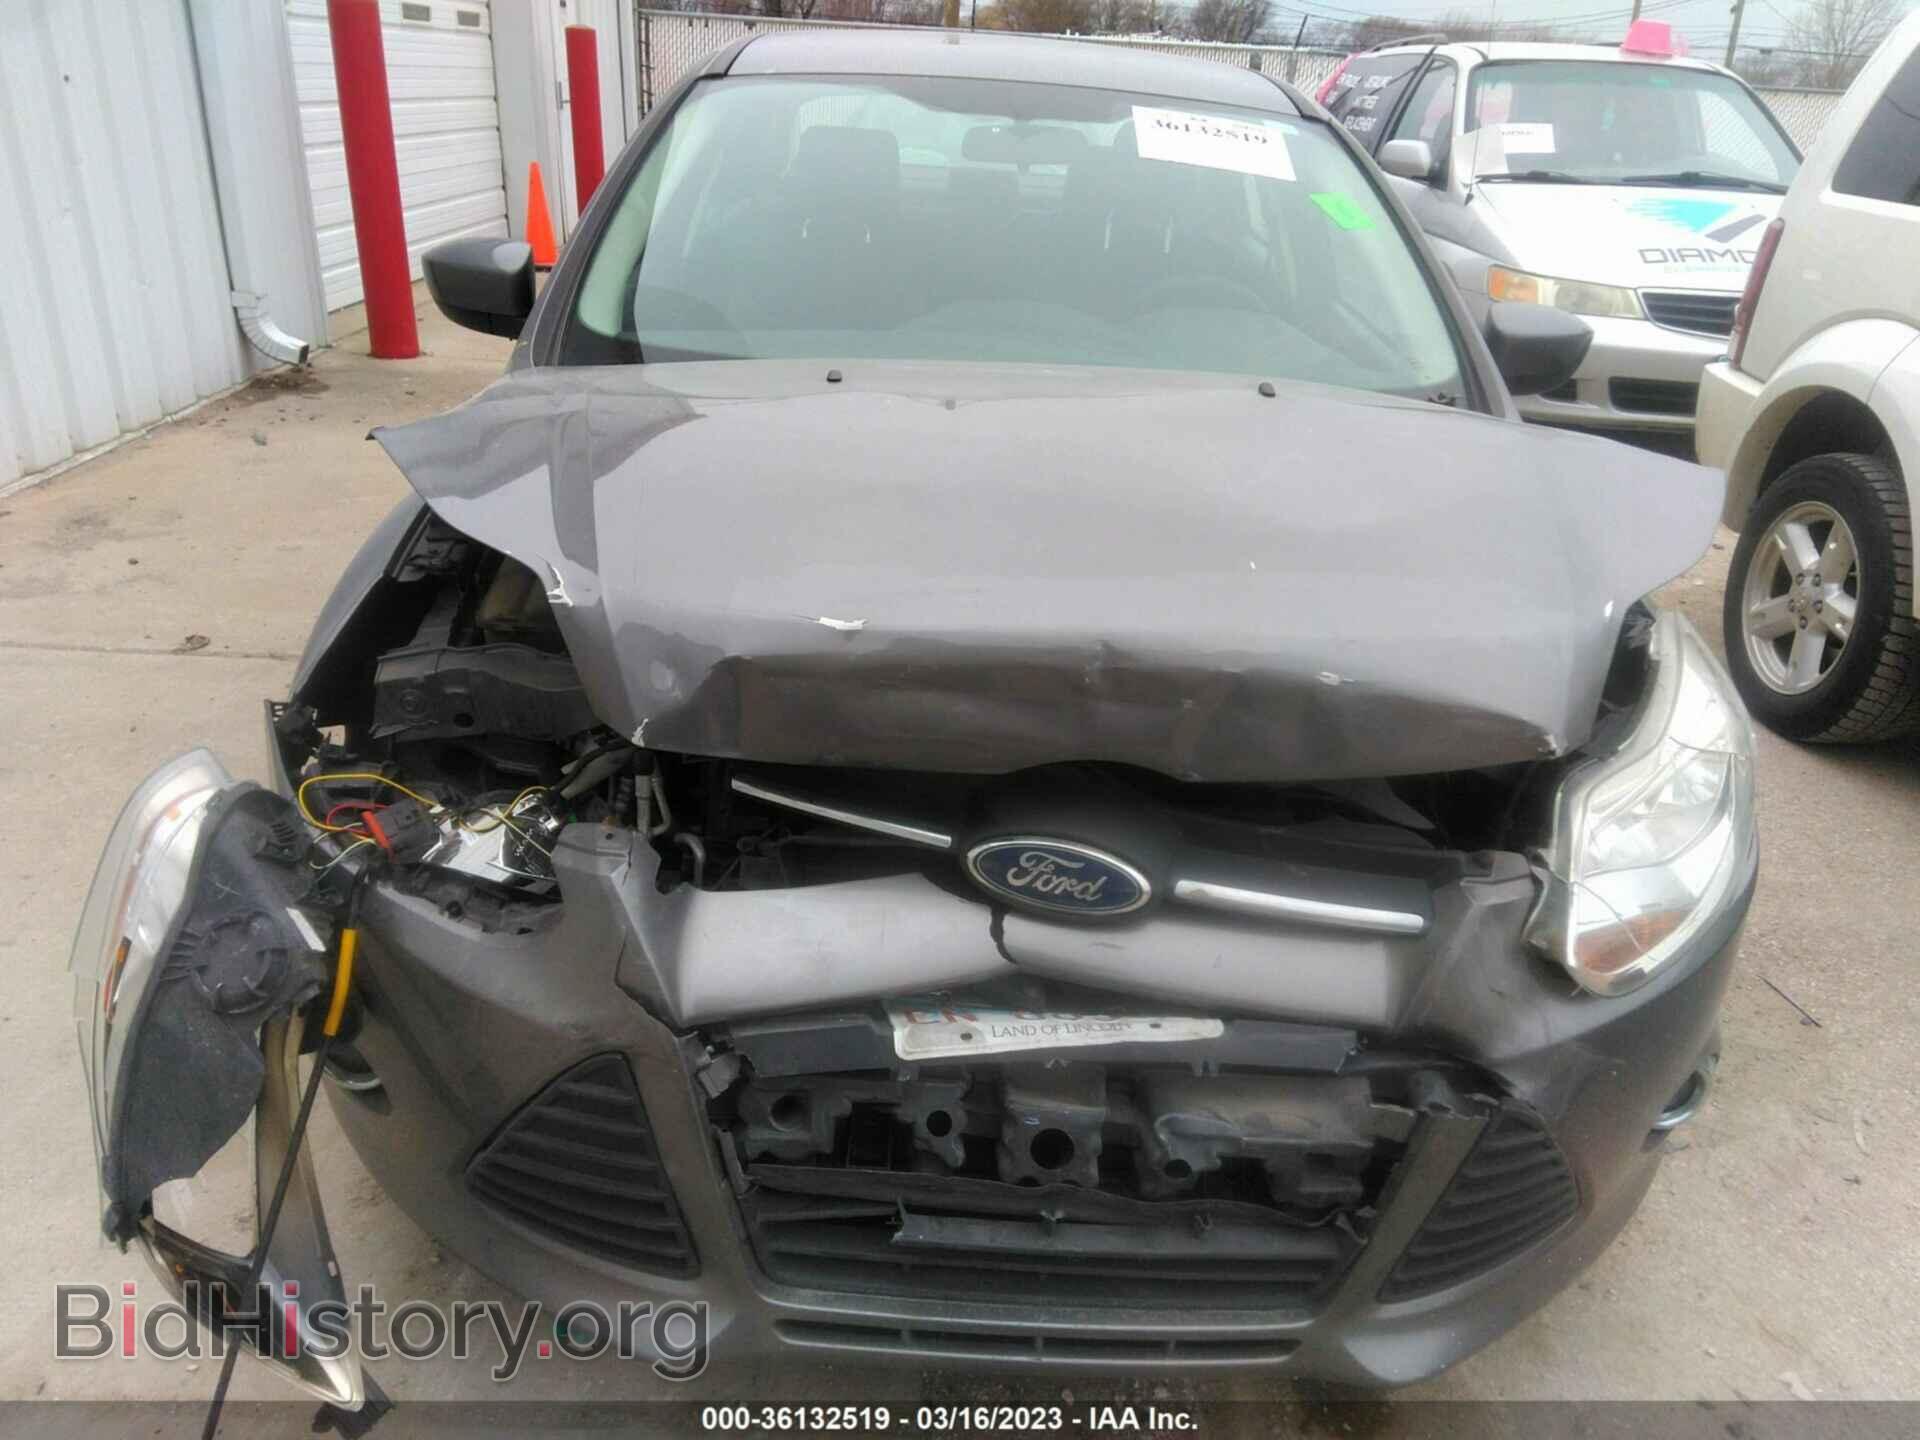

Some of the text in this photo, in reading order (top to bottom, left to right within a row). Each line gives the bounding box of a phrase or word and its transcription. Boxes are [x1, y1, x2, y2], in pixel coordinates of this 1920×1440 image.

[1006, 851, 1107, 901] Ford
[991, 1023, 1037, 1038] LAND
[1041, 1023, 1059, 1036] OF
